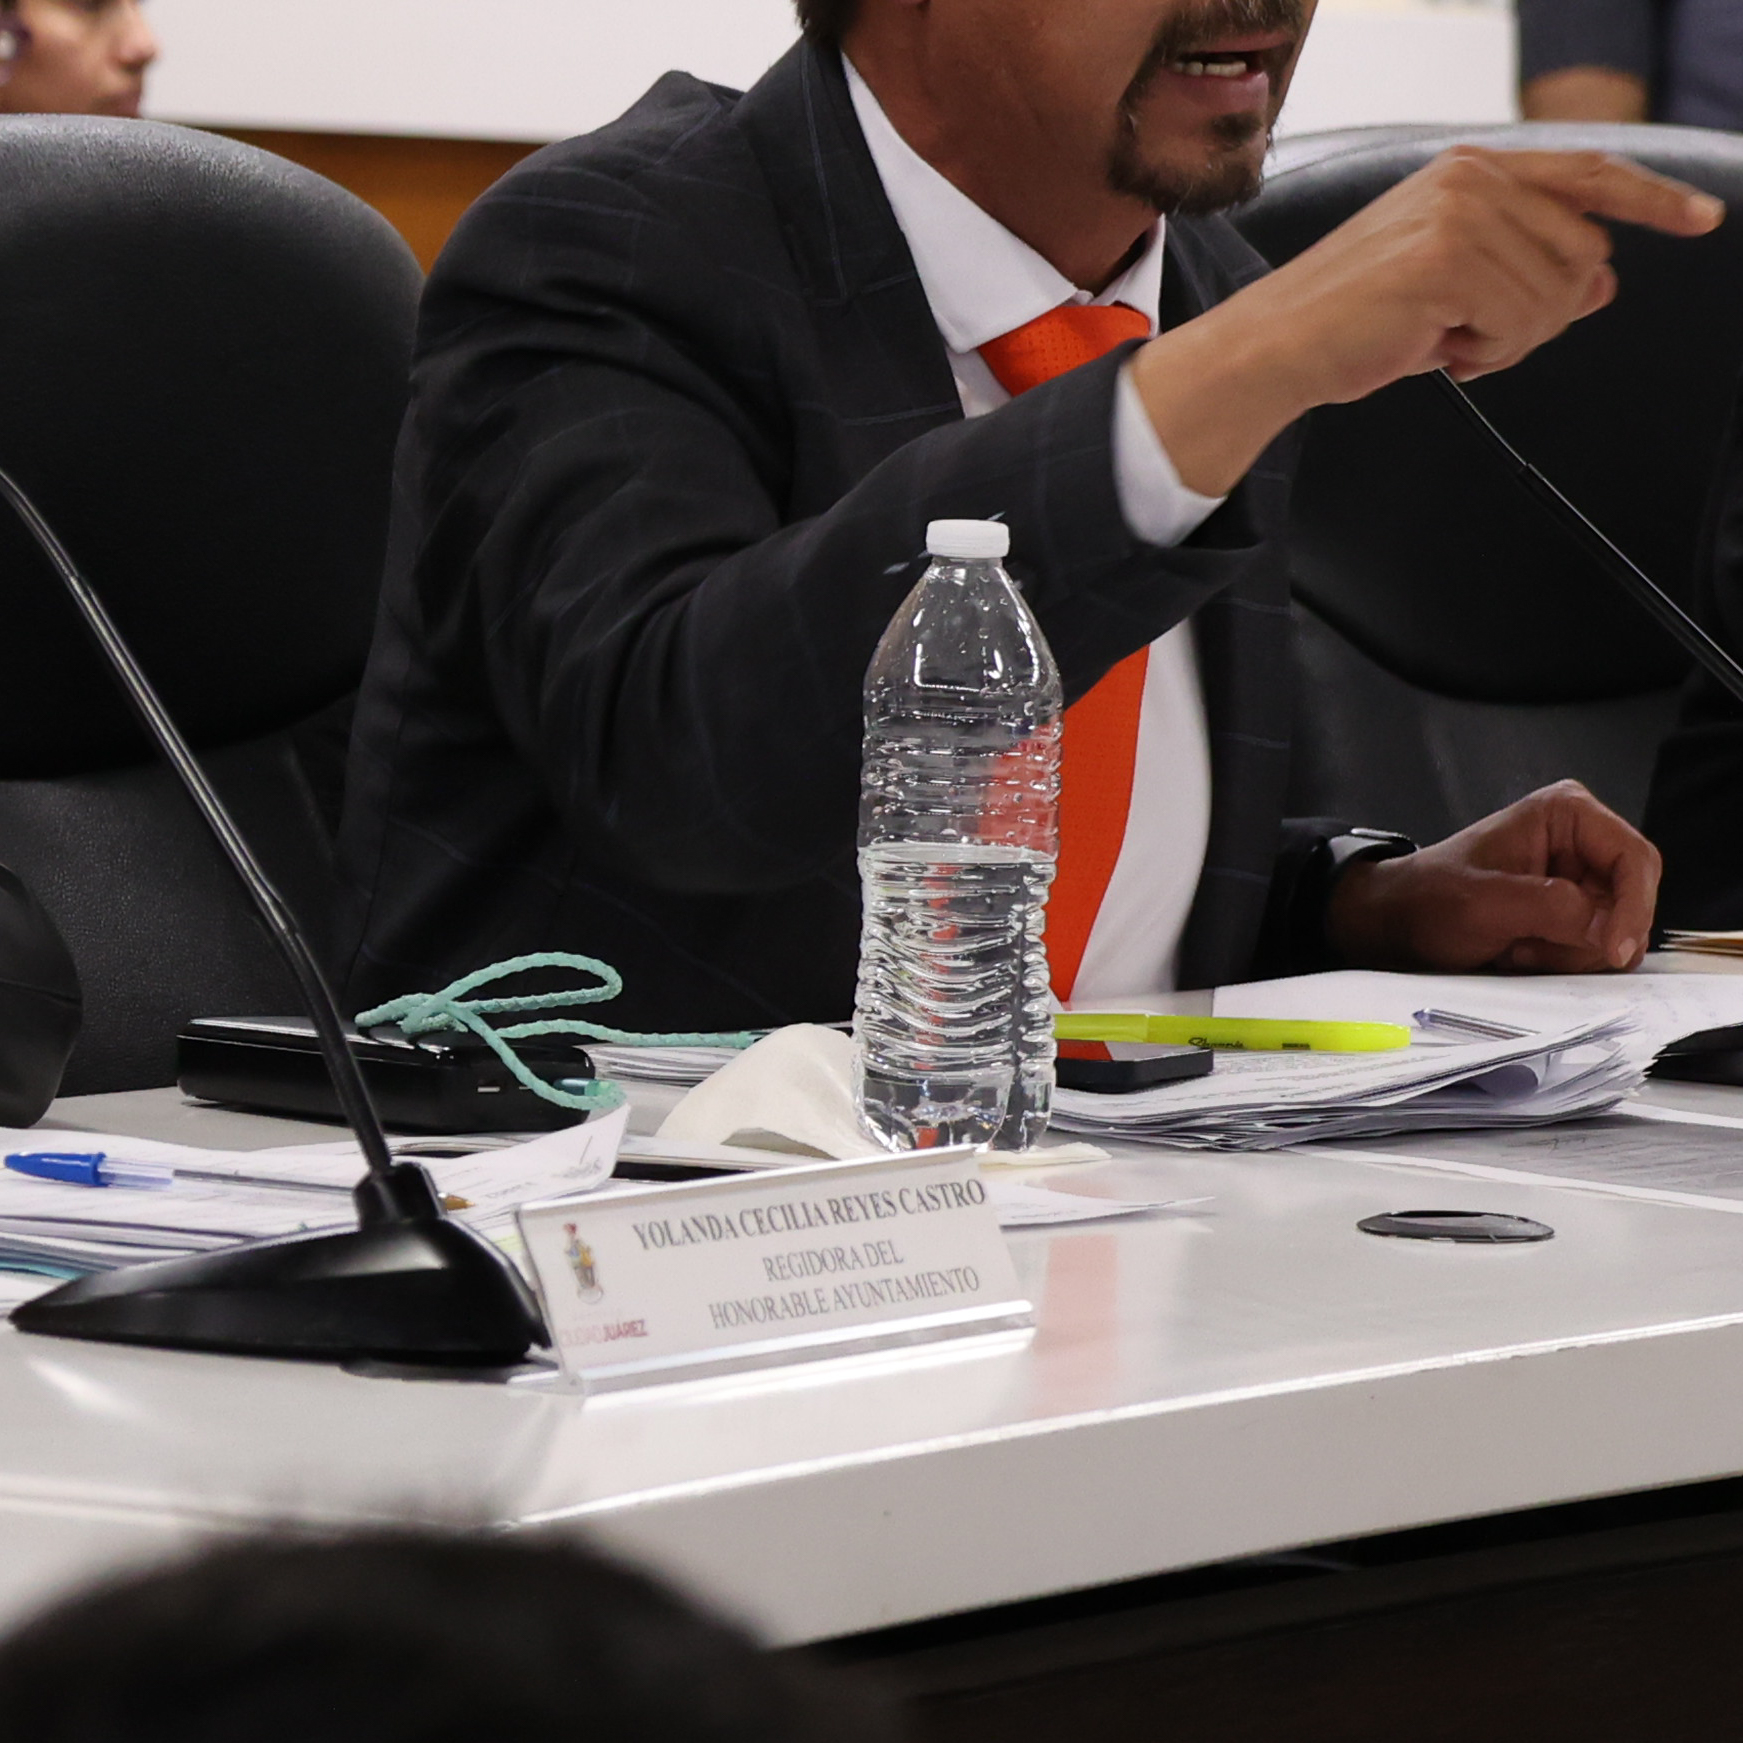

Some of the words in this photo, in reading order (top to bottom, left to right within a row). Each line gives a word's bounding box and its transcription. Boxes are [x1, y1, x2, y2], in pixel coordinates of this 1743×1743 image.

[632, 1213, 739, 1250] YOLANDA
[739, 1202, 829, 1236] CECILIA
[827, 1190, 897, 1225] REYES
[898, 1179, 986, 1215] CASTRO
[763, 1243, 863, 1282] REGIDORA
[863, 1239, 904, 1266] DEL
[710, 1287, 831, 1329] HONORABLE
[833, 1266, 980, 1311] AYUNTAMIENTO
